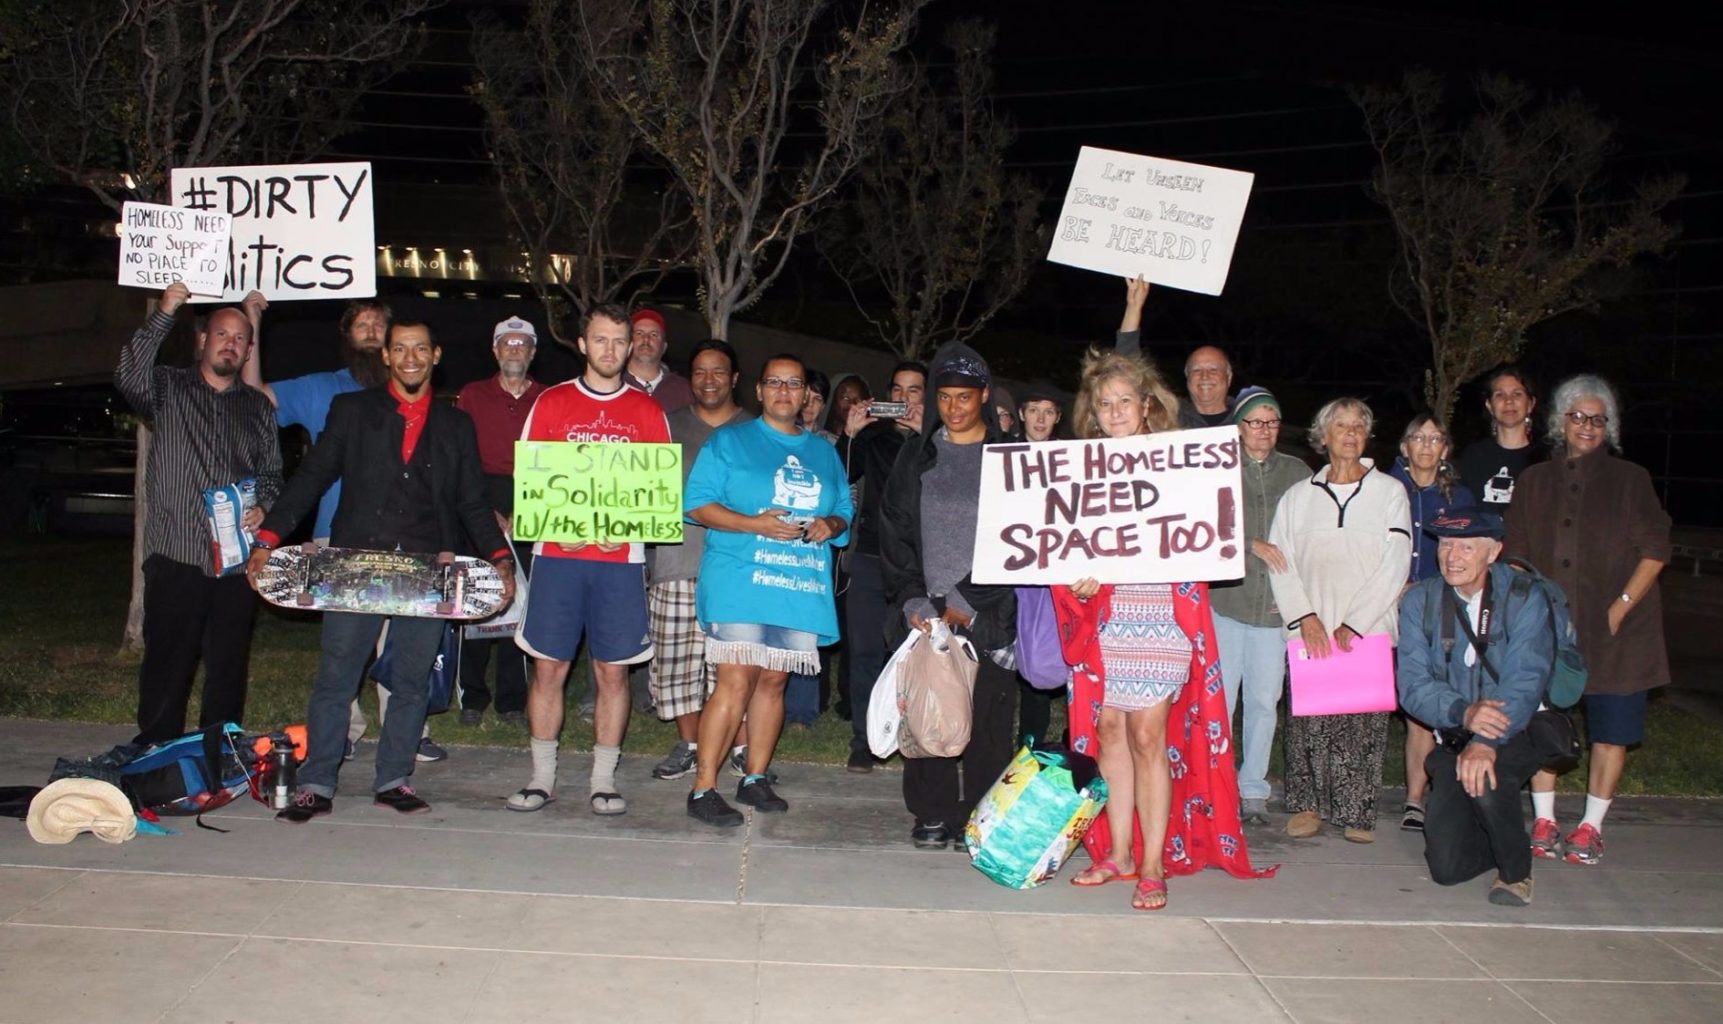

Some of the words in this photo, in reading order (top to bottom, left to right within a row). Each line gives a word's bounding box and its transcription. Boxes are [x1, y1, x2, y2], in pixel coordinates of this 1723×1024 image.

[1101, 162, 1136, 183] LET
[182, 169, 368, 222] #DIRTY
[128, 207, 185, 231] HOMELESS
[194, 214, 226, 232] NEED
[1159, 200, 1215, 231] VOICES
[1060, 216, 1093, 243] BE
[1105, 223, 1212, 265] HEARD!
[126, 252, 143, 264] NO
[200, 259, 218, 272] TO
[223, 235, 355, 291] litics
[390, 258, 440, 270] RESNO
[566, 431, 631, 443] CHICAGO
[527, 444, 553, 473] I
[574, 444, 678, 474] STAND
[986, 444, 1071, 492] THE
[545, 474, 679, 514] Solidarity
[1044, 480, 1160, 525] NEED
[1000, 523, 1142, 571] SPACE
[504, 622, 518, 631] YO
